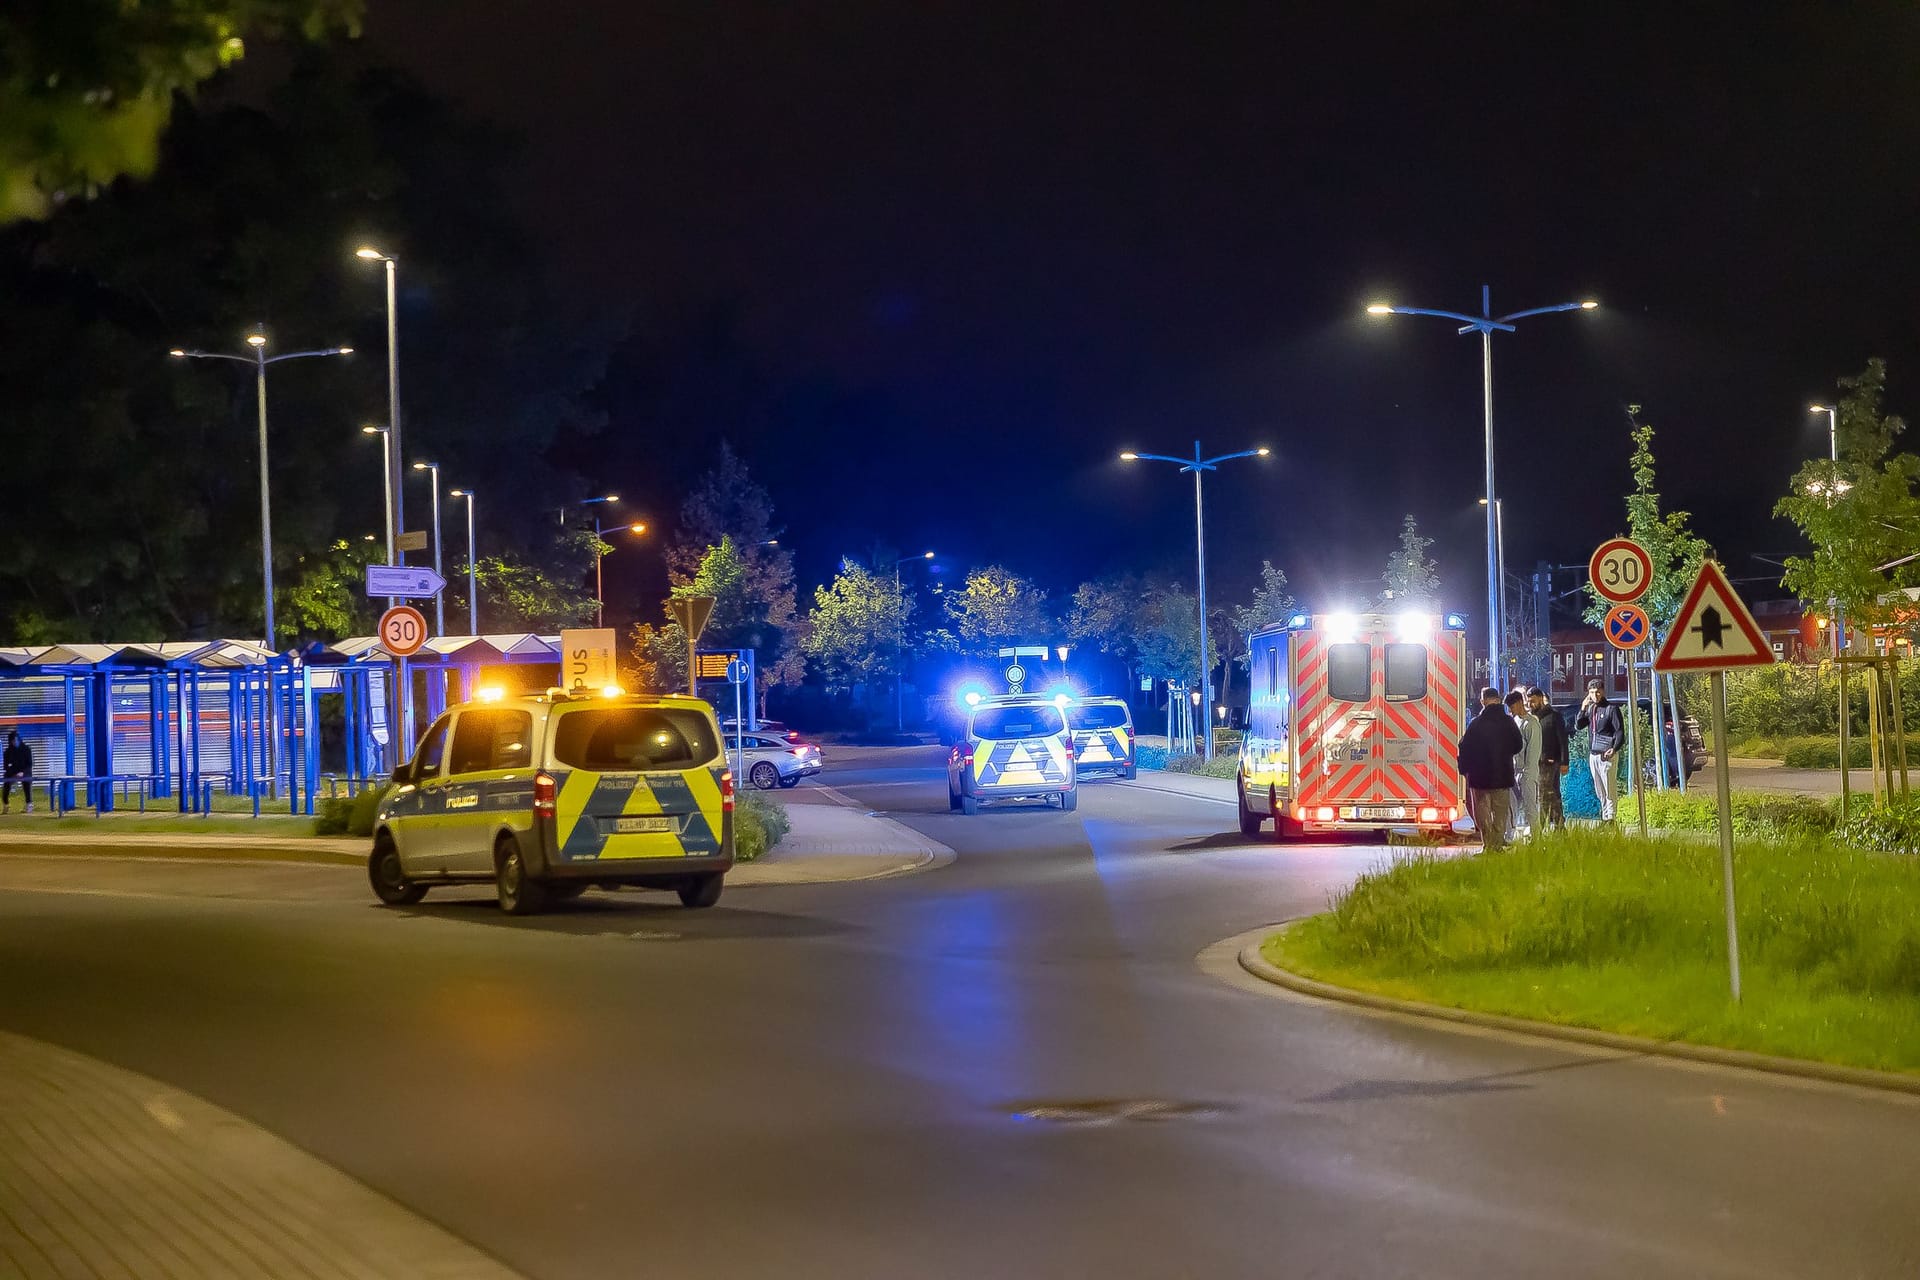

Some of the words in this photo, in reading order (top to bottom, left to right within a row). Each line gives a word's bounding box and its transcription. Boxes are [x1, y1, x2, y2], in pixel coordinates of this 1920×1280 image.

[1604, 557, 1639, 586] 30
[390, 620, 415, 642] 30
[1010, 670, 1021, 679] 30
